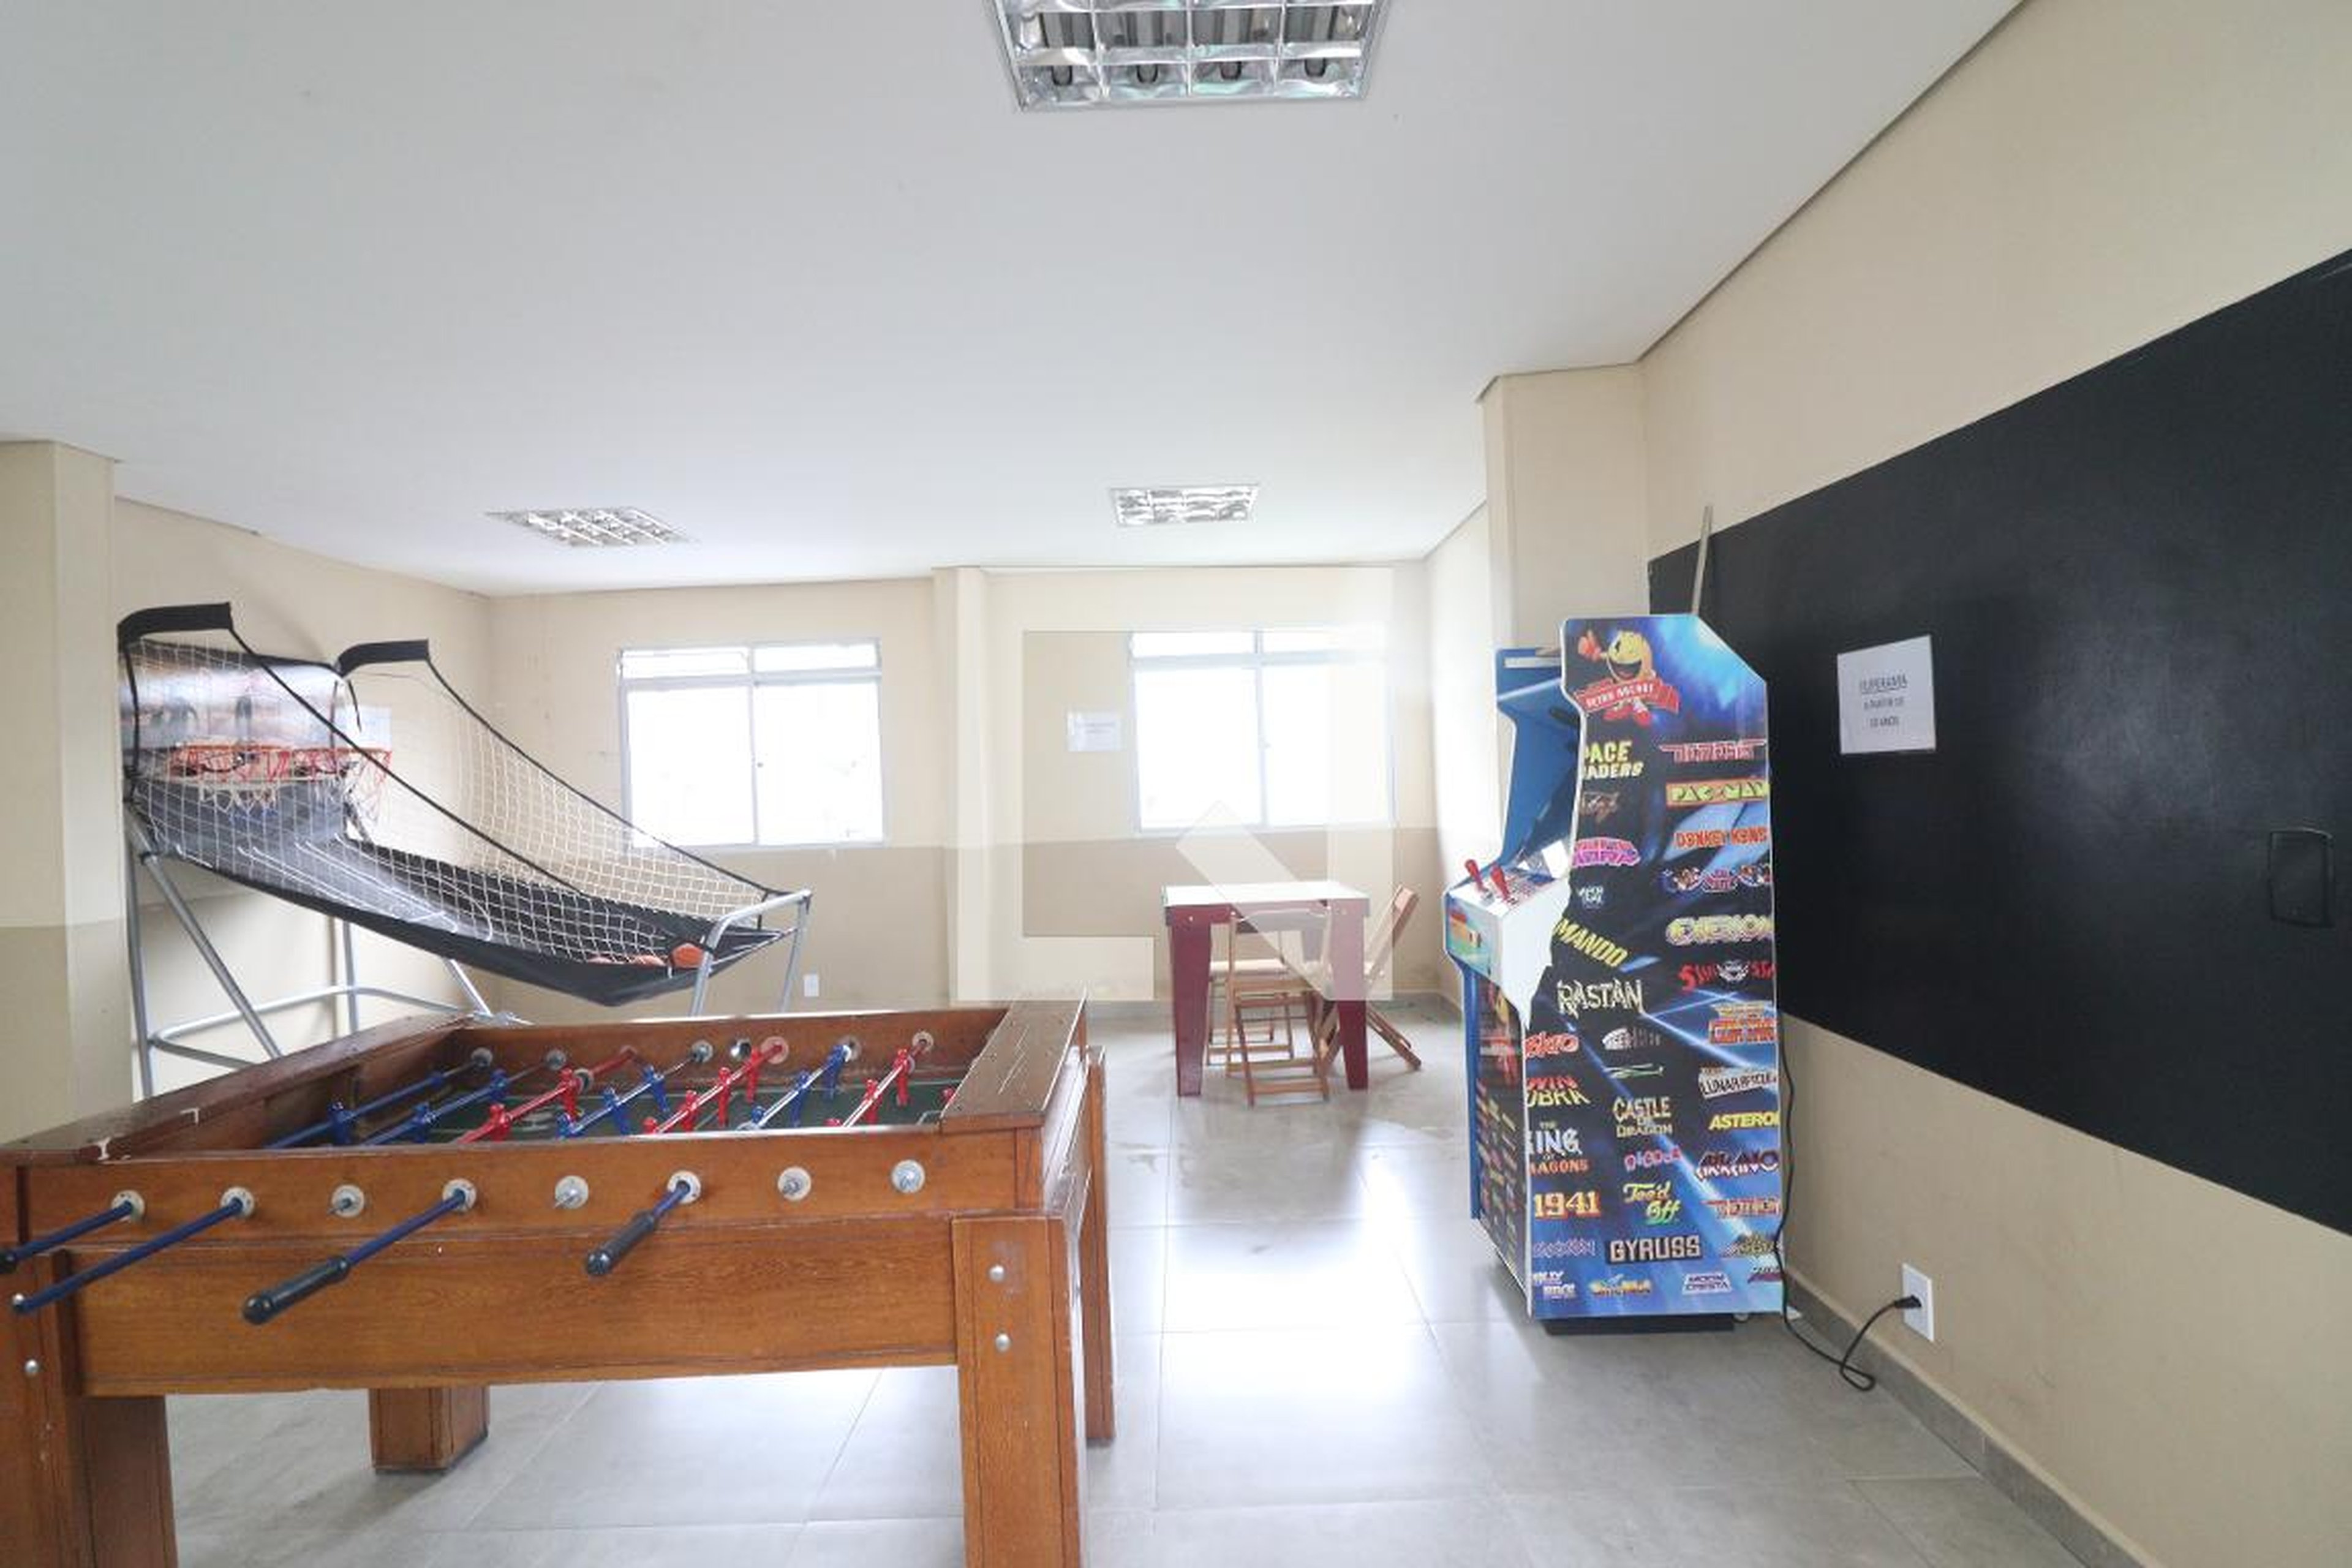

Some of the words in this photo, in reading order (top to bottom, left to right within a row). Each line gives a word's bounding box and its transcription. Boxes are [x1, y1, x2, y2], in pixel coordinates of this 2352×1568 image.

[1583, 761, 1644, 780] ADERS
[1557, 978, 1646, 1019] RASTAN
[1612, 1096, 1672, 1122] CASTLE
[1533, 1191, 1602, 1221] 1941
[1610, 1235, 1702, 1262] GYRUSS
